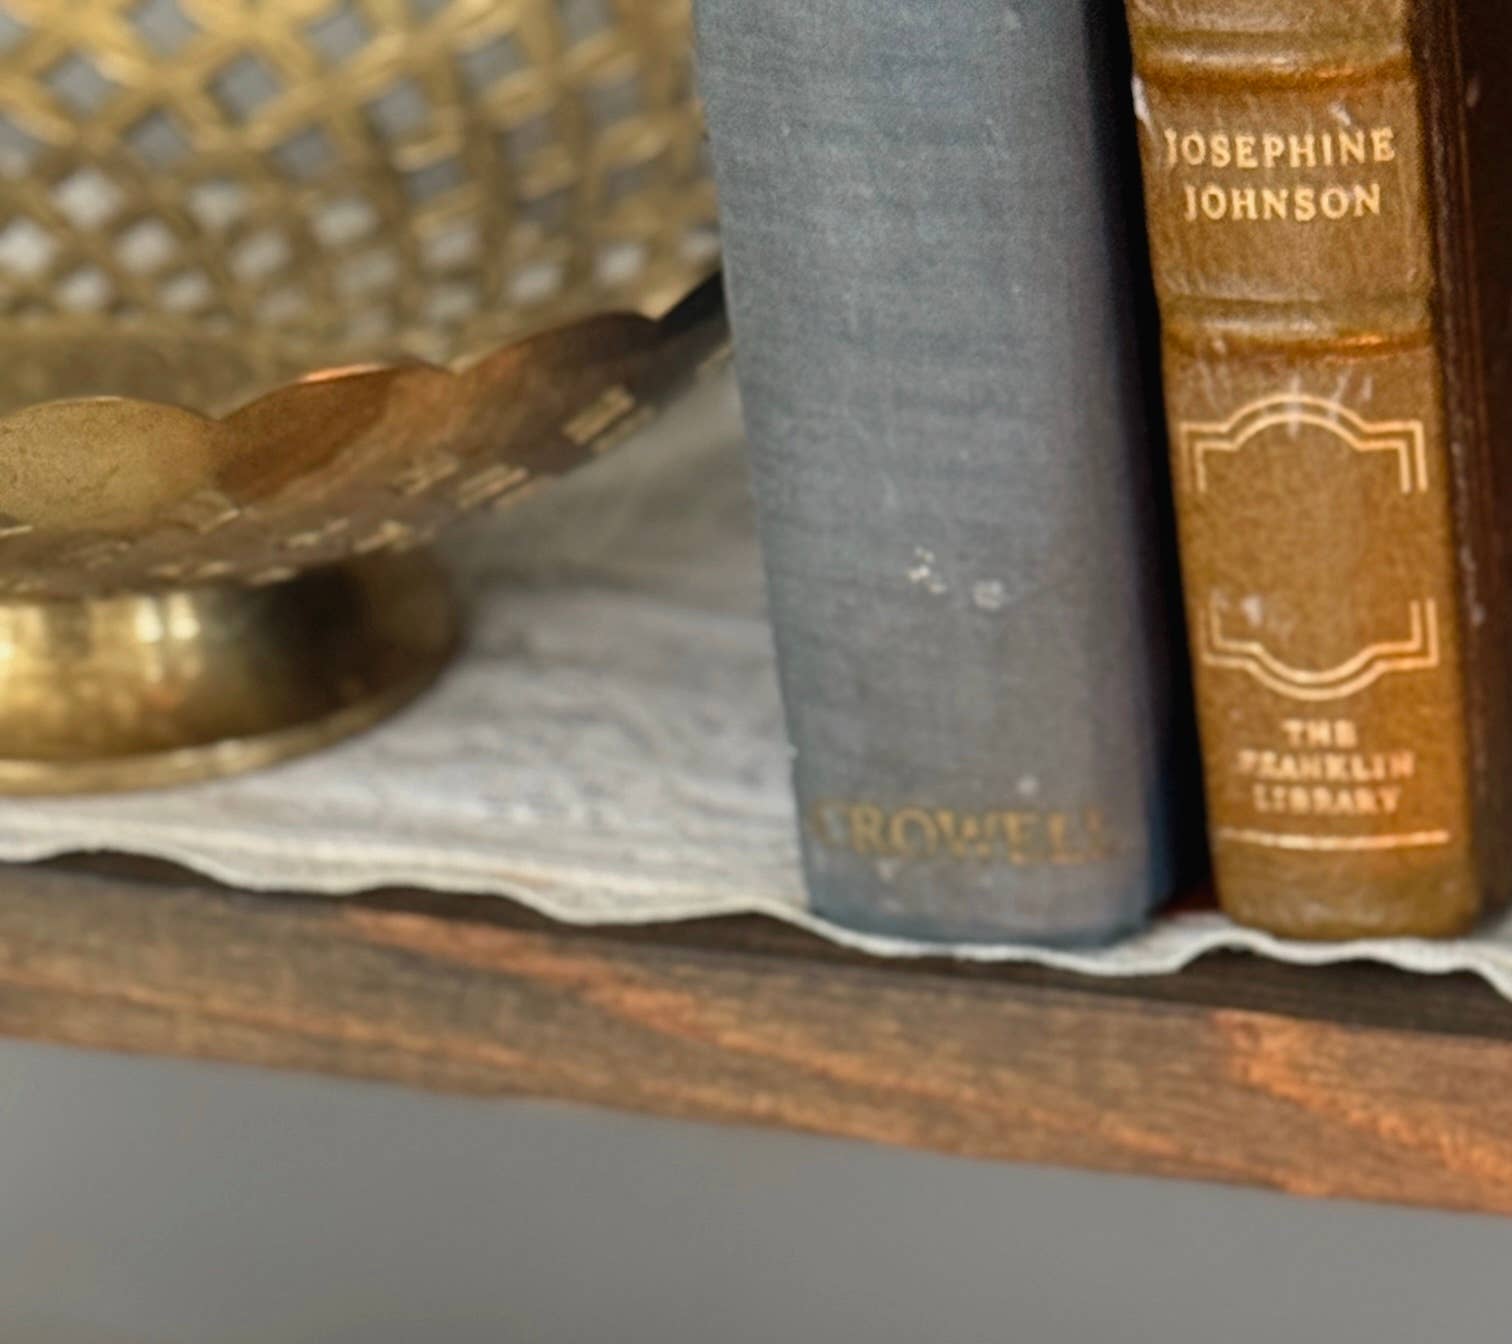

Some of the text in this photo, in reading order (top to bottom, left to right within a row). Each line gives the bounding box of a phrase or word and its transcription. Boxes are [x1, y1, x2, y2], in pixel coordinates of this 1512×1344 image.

[1163, 127, 1396, 168] JOSEPHINE
[1184, 182, 1382, 222] JOHNSON
[1281, 718, 1358, 748] THE
[1236, 749, 1415, 782] FRANKLIN
[1252, 784, 1399, 815] LIBRARY
